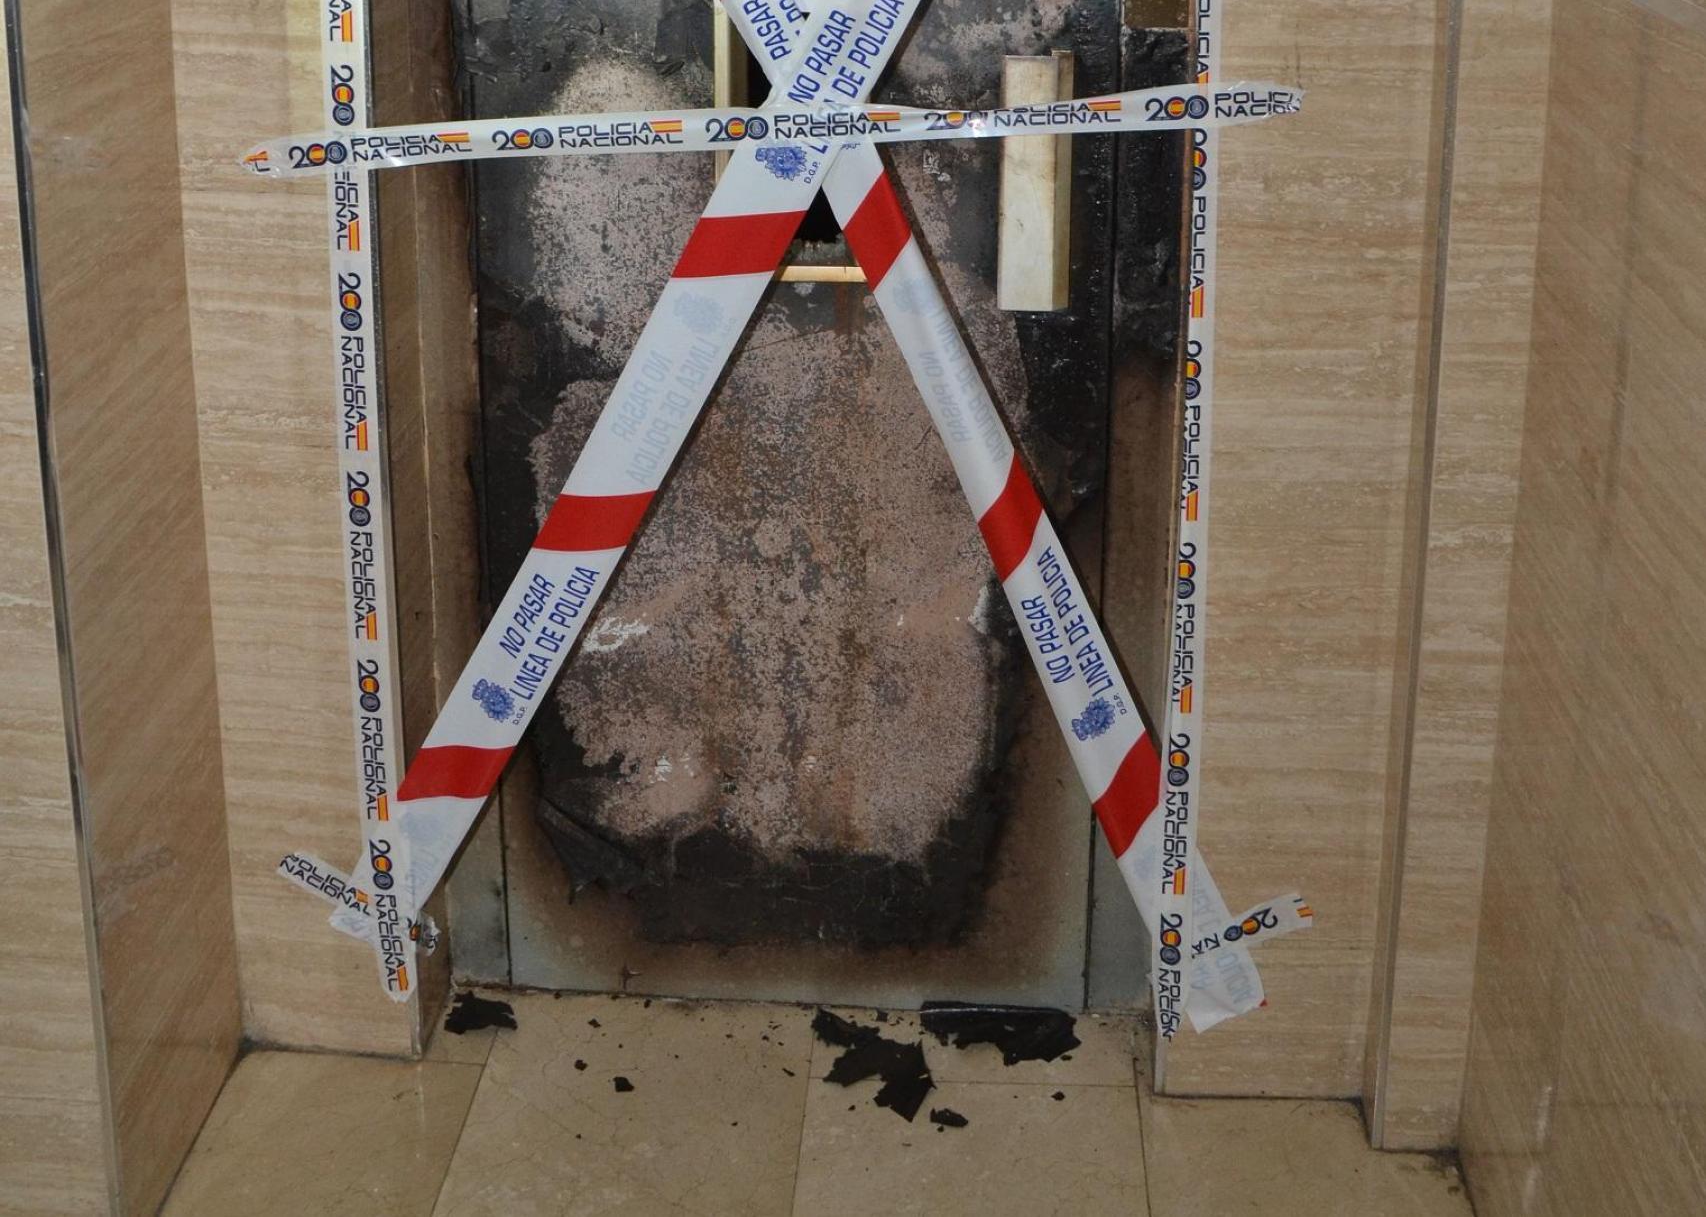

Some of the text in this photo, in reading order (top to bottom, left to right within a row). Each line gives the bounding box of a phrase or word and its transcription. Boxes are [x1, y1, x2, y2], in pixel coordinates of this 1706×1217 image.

[787, 73, 820, 103] NO
[805, 10, 856, 76] PASAR
[831, 66, 866, 98] DE
[353, 143, 473, 162] NACIONAL
[560, 134, 684, 149] NACIONAL
[775, 121, 901, 139] NACIONAL
[994, 111, 1121, 127] NACIONAL
[341, 335, 357, 450] NACIONAL
[350, 531, 367, 639] NACIONAL
[499, 574, 556, 659] NO PASAR
[1037, 546, 1114, 698] LINEA DE POLICIA
[509, 566, 600, 700] LINEA DE POLICIA
[1021, 595, 1076, 684] NO PASAR
[360, 716, 378, 820] NACIONAL
[279, 860, 370, 916] NACIONAL
[1162, 791, 1177, 894] NACIONAL
[375, 894, 398, 991] NACIONAL
